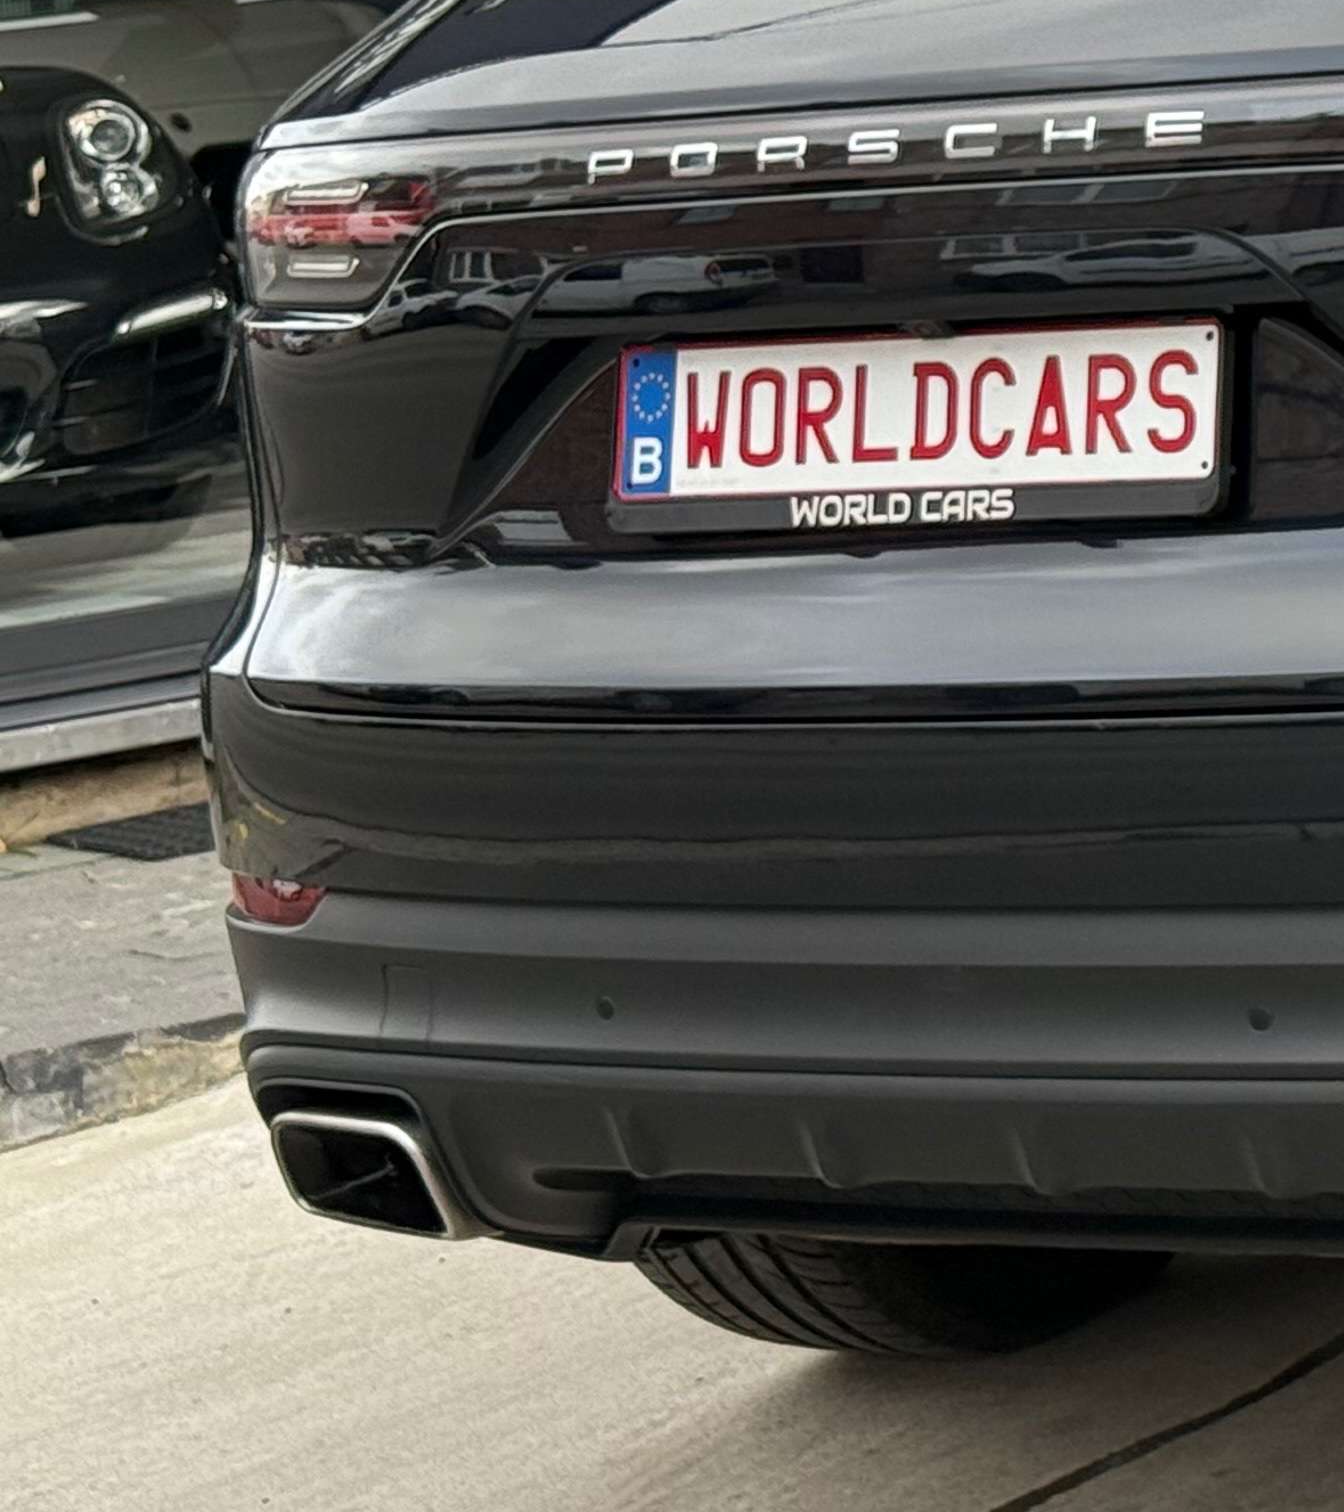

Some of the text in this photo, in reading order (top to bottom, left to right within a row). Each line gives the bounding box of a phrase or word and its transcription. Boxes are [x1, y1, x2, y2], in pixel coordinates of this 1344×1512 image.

[587, 110, 1205, 185] PORSCHE
[631, 349, 1199, 485] B WORLDCARS
[790, 488, 1015, 528] WORLD CARS
